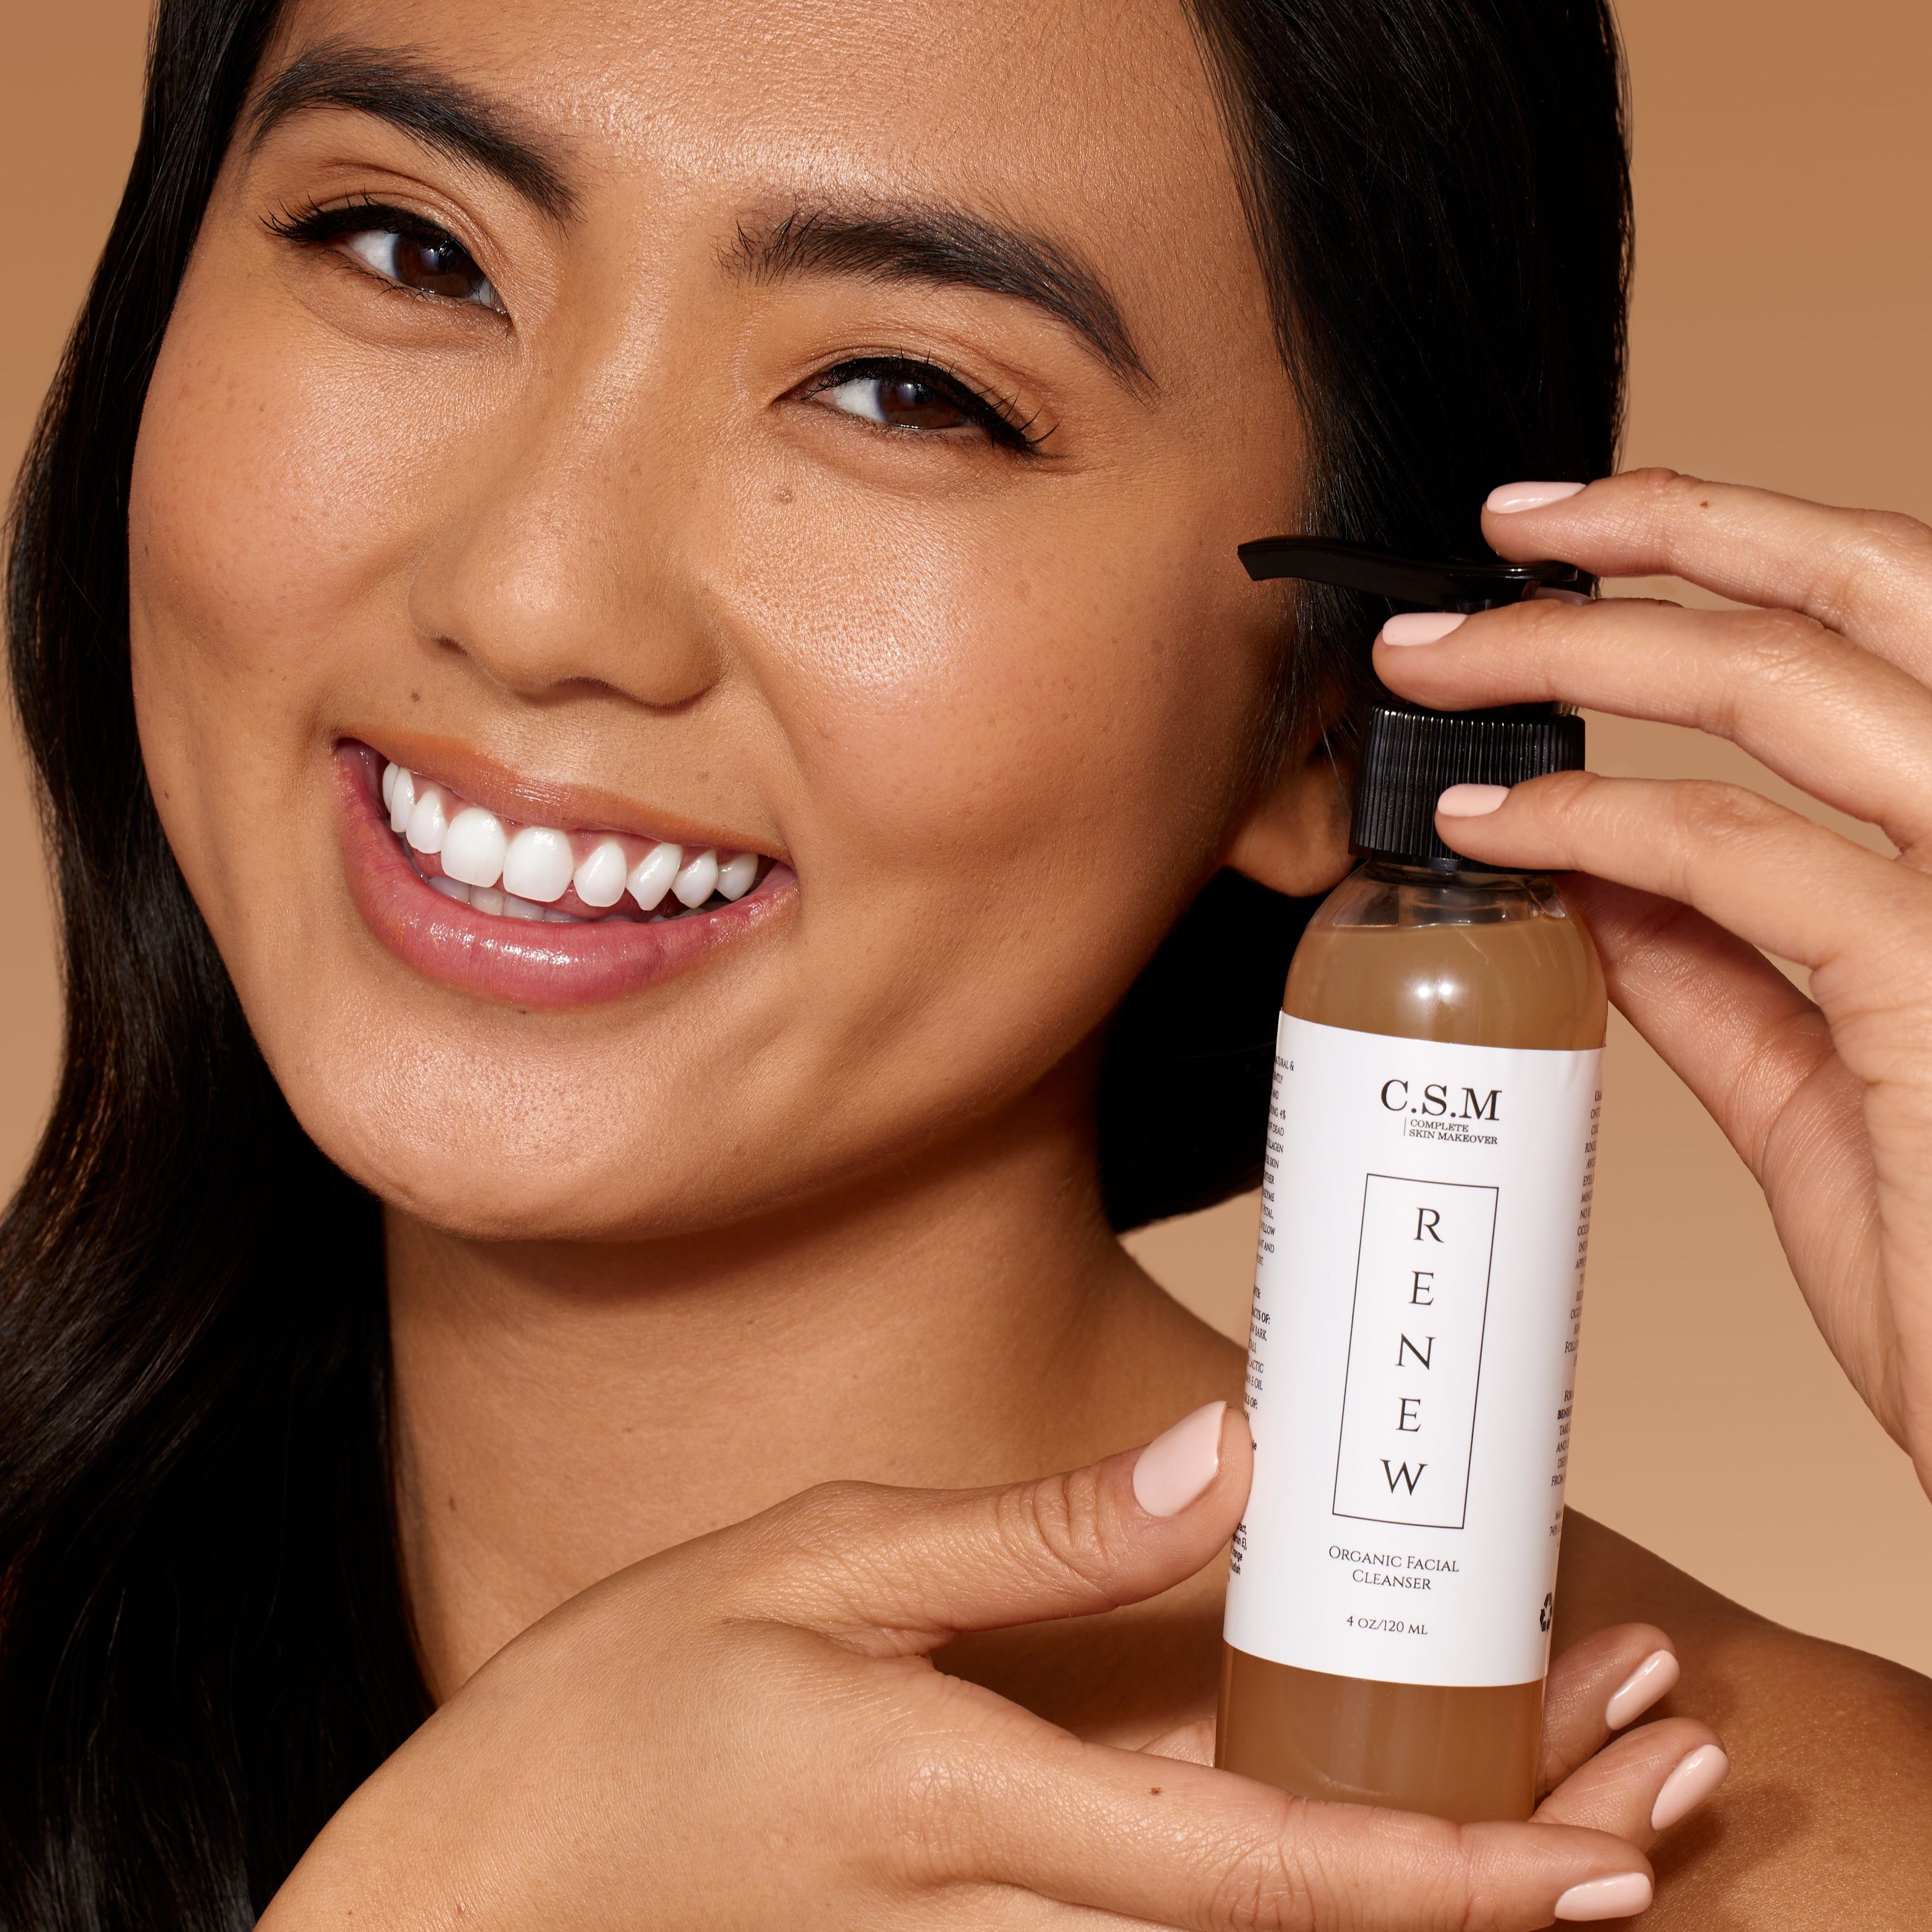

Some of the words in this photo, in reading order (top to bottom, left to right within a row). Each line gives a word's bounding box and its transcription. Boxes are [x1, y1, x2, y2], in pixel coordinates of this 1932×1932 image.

[1275, 1056, 1289, 1069] ATURAL
[1290, 1061, 1294, 1071] &
[1381, 1080, 1502, 1121] C.S.M
[1273, 1124, 1284, 1136] DEAD
[1410, 1119, 1469, 1133] COMPLETE
[1409, 1129, 1435, 1140] SKIN
[1438, 1132, 1498, 1144] MAKEOVER
[1266, 1138, 1284, 1153] OLLAGEN
[1270, 1156, 1279, 1168] SKIN
[1264, 1242, 1274, 1253] AND
[1261, 1313, 1270, 1324] OF:
[1380, 1207, 1444, 1496] RENEW
[1254, 1378, 1263, 1390] OIL
[1232, 1545, 1242, 1562] range
[1347, 1616, 1353, 1627] 4
[1408, 1625, 1428, 1635] ML
